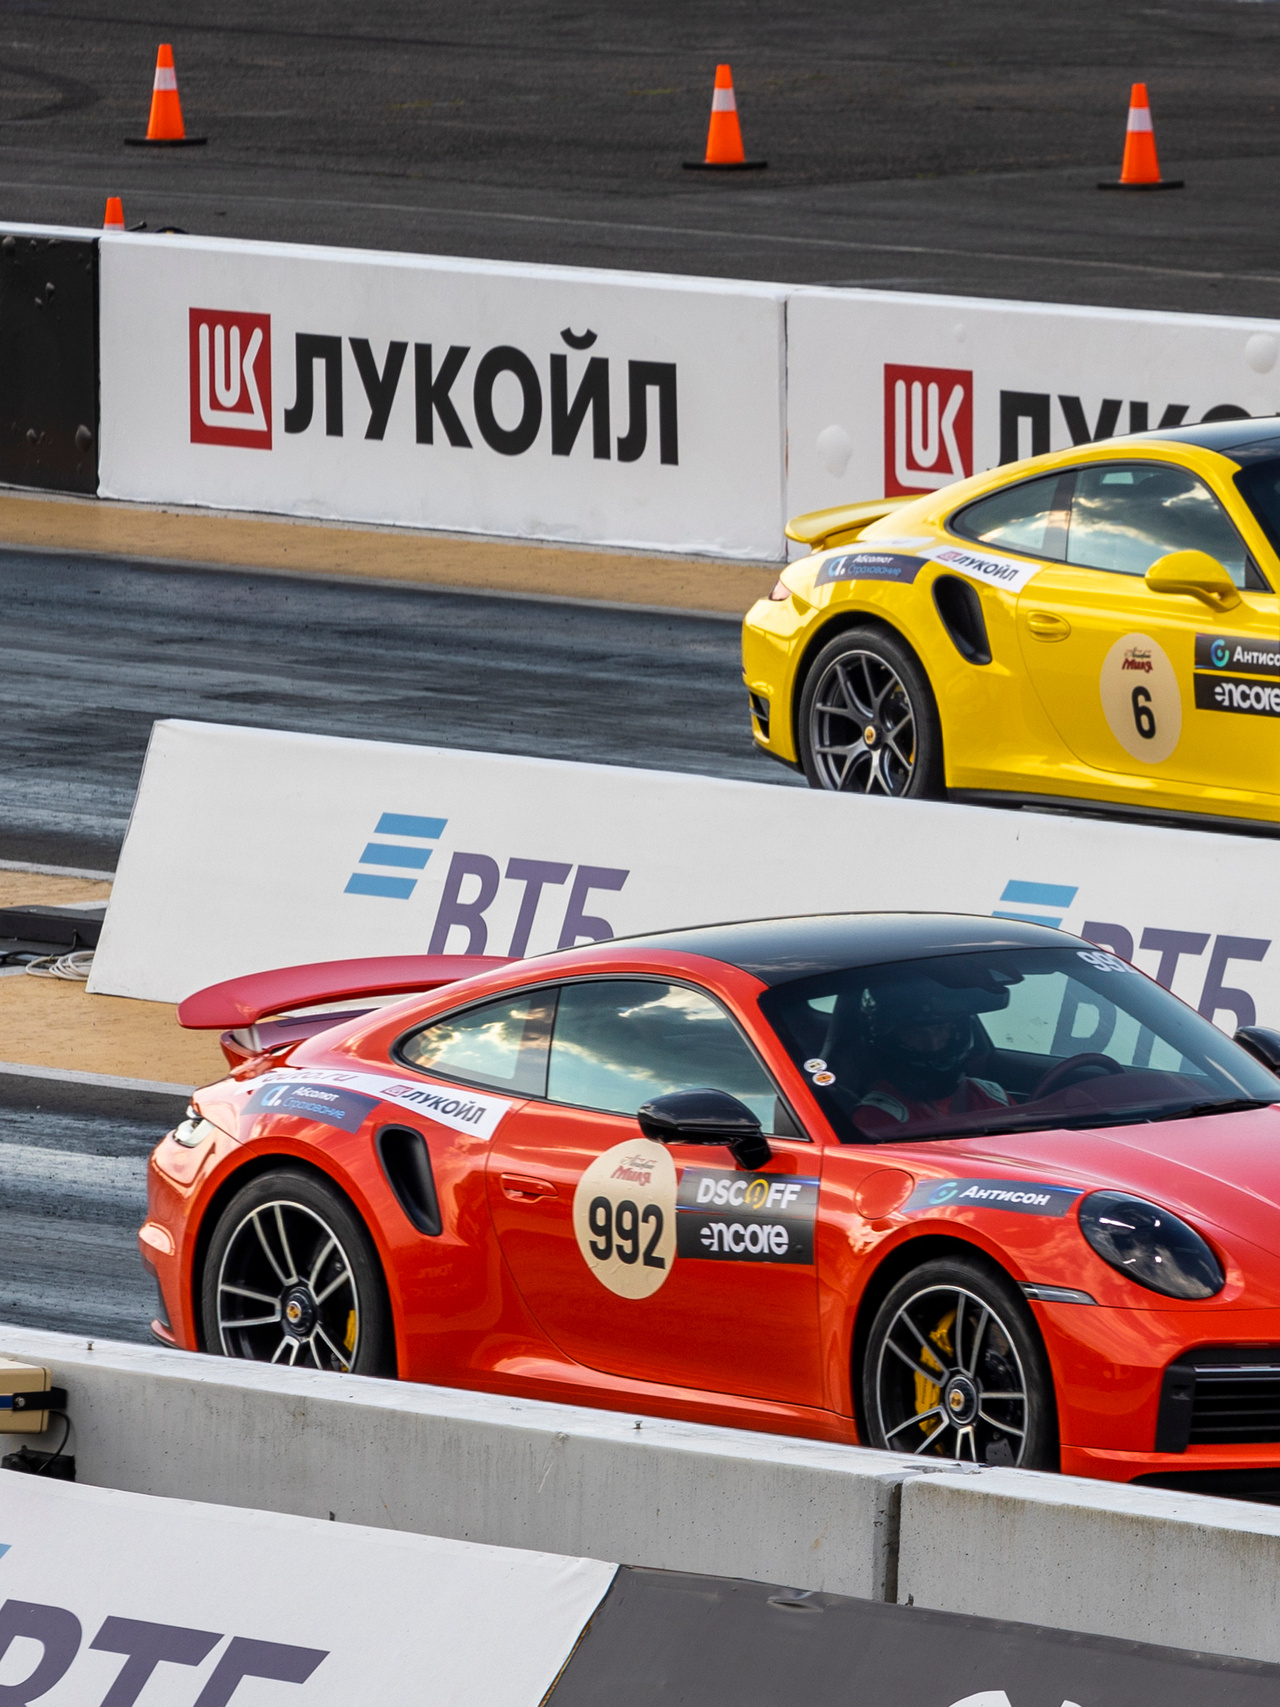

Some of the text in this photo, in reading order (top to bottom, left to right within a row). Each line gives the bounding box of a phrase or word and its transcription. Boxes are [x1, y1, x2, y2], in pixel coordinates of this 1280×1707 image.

[284, 326, 679, 466] ЛУКОЙЛ
[951, 553, 1019, 581] ЛУКОЙЛ
[1131, 685, 1156, 739] 6
[282, 1096, 346, 1119] Страхование
[291, 1086, 340, 1101] Абсолют
[401, 1090, 486, 1125] ЛУКОЙЛ
[589, 1196, 666, 1269] 992
[700, 1222, 789, 1255] encore
